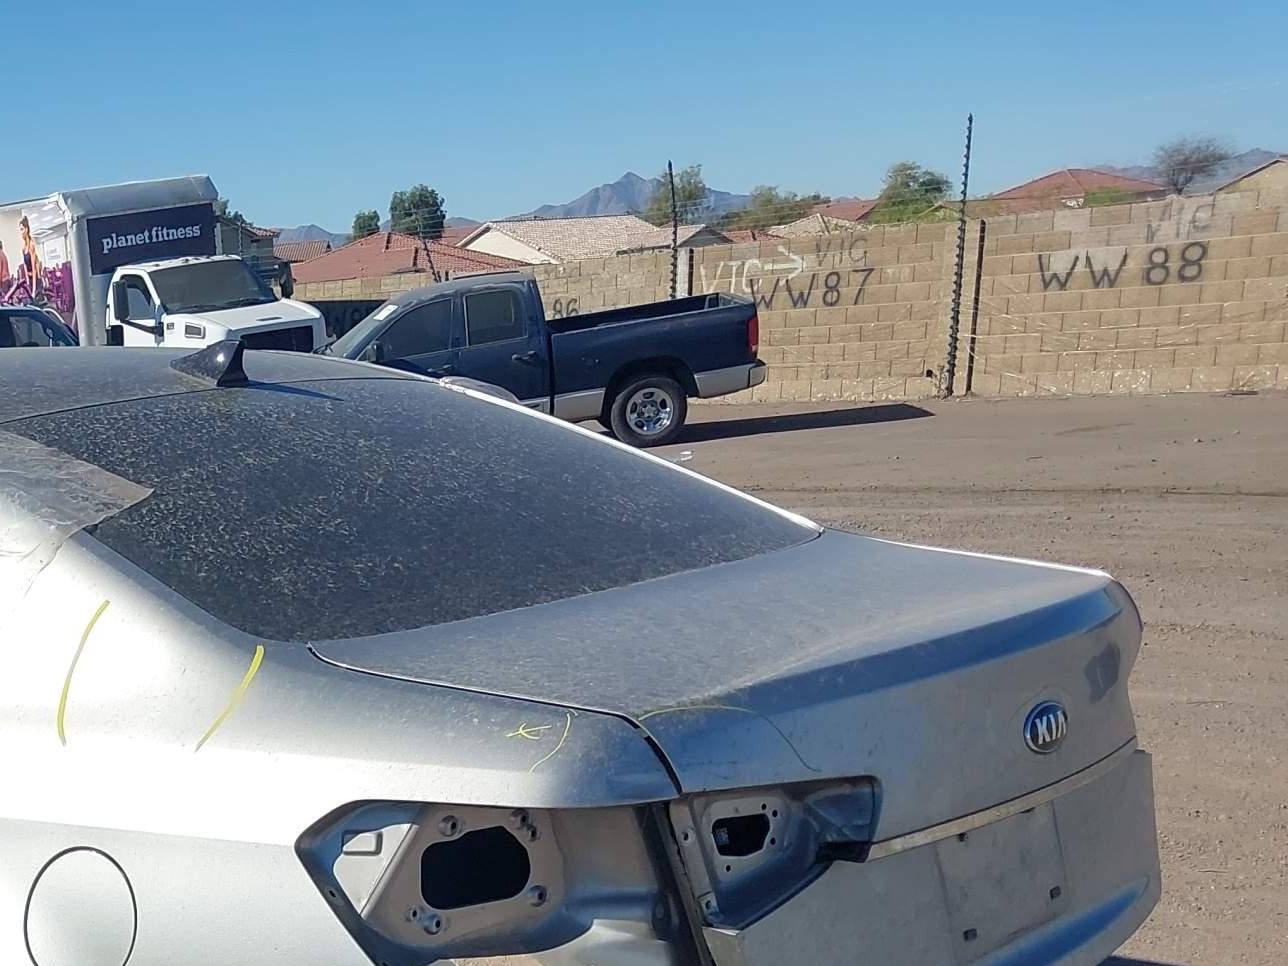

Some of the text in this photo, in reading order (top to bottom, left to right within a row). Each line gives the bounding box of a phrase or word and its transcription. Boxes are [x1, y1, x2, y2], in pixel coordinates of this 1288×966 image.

[102, 225, 201, 254] planet fitness
[1034, 710, 1066, 745] KIA
